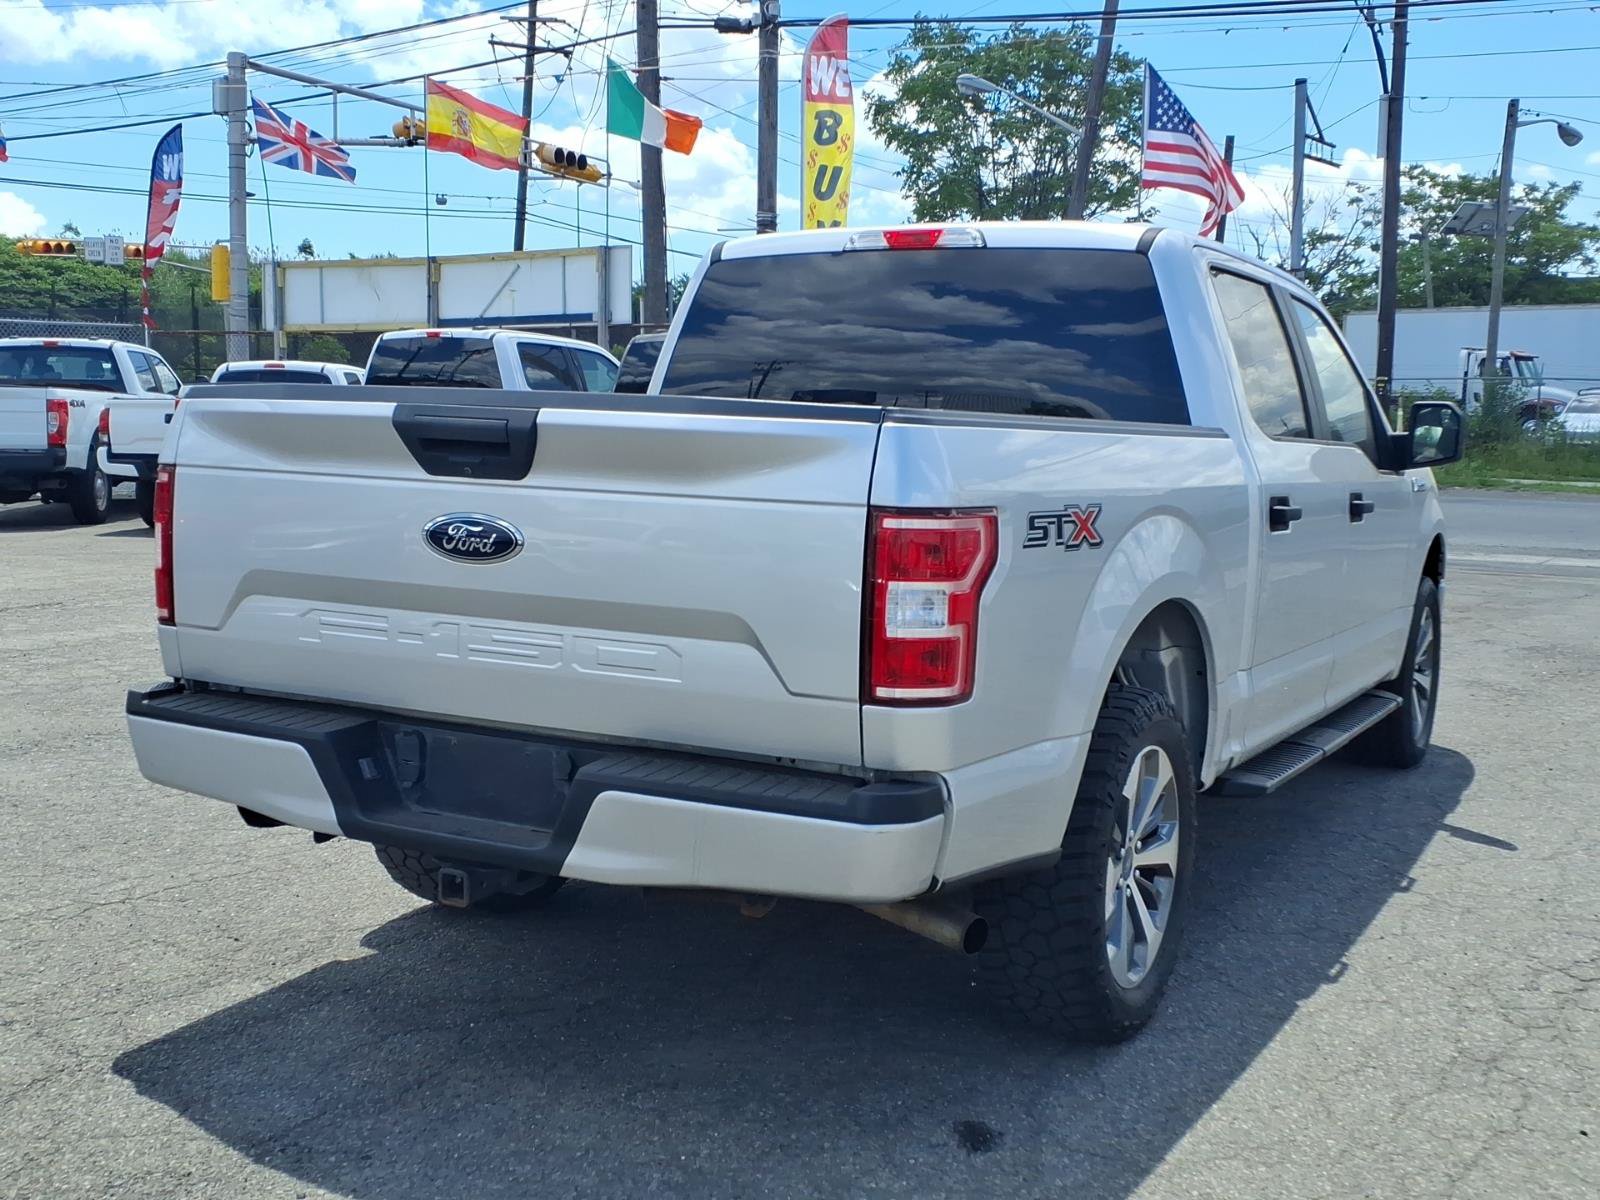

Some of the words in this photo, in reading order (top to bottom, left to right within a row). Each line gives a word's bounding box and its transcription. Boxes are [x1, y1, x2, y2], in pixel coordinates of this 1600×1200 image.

[810, 55, 851, 97] WE
[442, 522, 497, 553] Ford
[1022, 503, 1104, 552] STX
[298, 608, 683, 683] F-150
